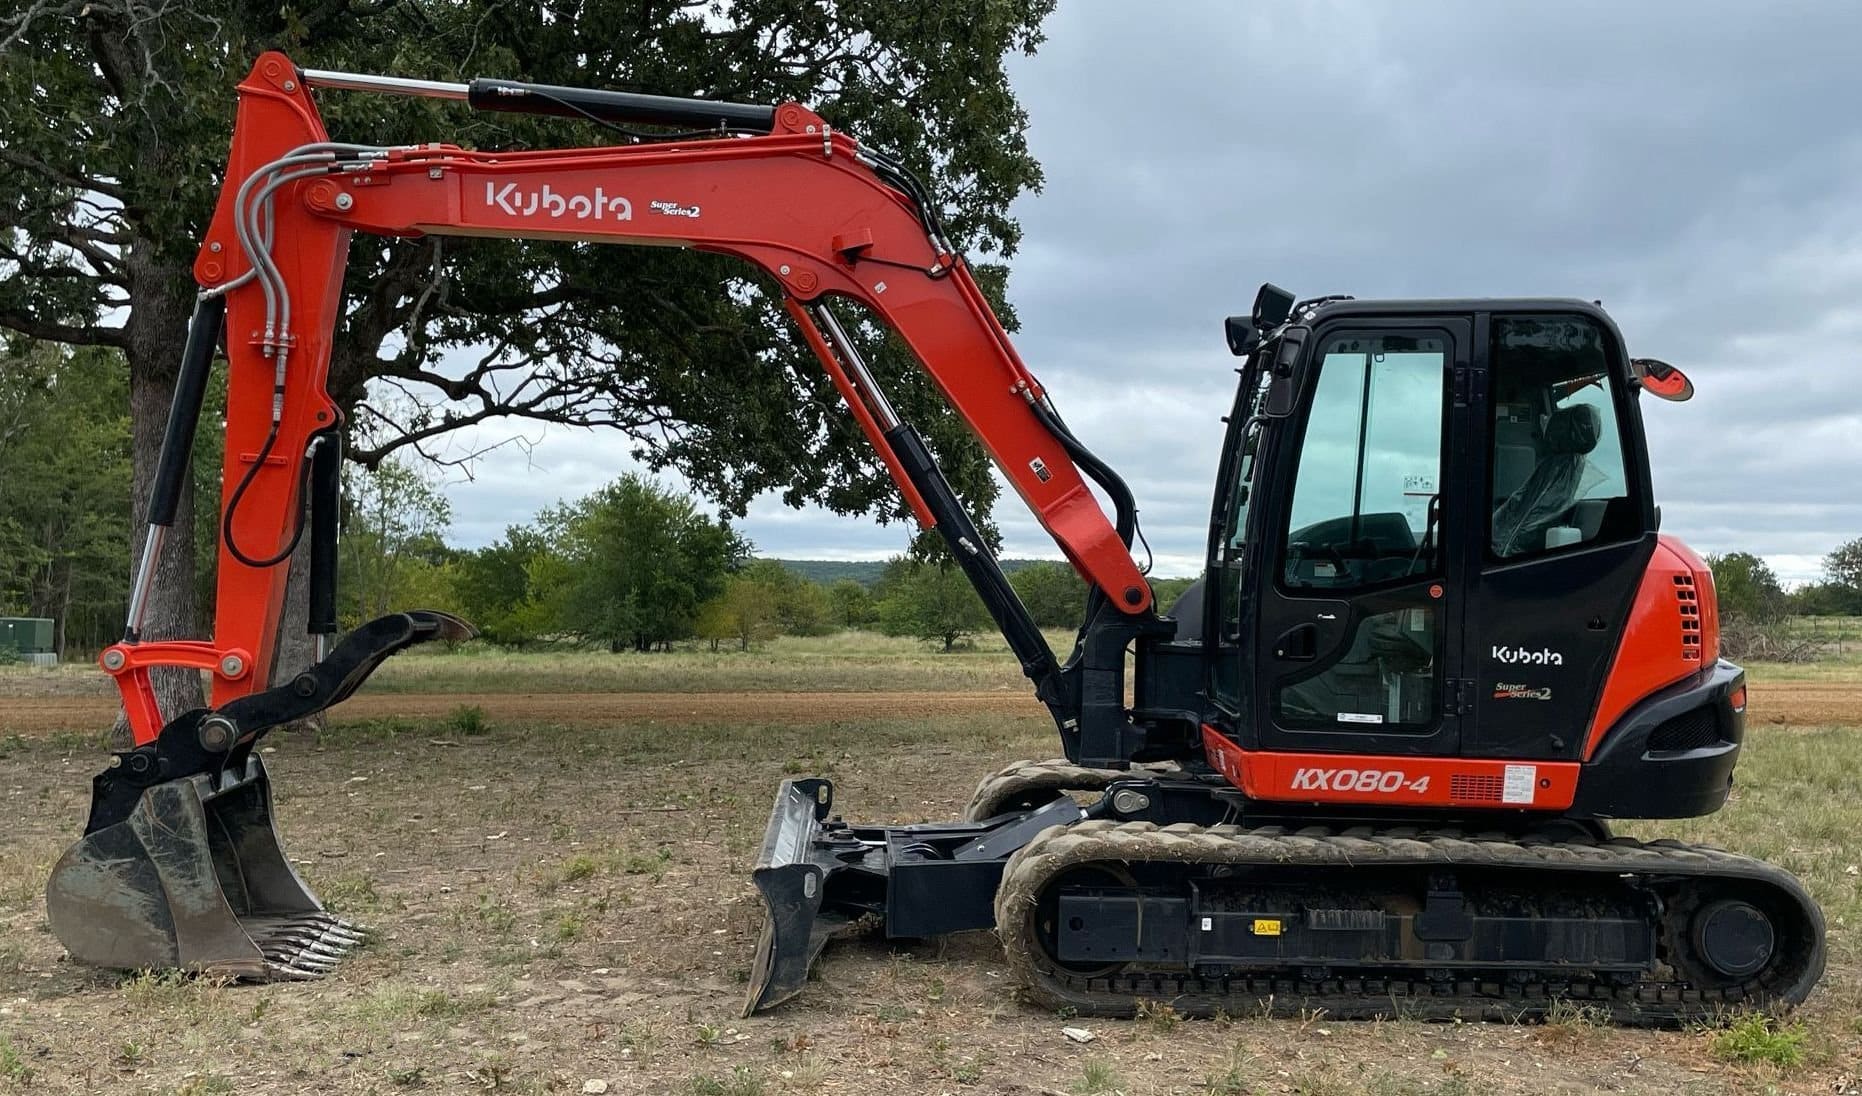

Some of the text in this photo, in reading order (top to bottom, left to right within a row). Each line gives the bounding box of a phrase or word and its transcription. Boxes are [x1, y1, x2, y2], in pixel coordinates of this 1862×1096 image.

[486, 182, 632, 221] Kubota
[650, 200, 678, 210] Super
[1492, 646, 1562, 665] Kubota
[1495, 682, 1527, 692] Super
[1291, 768, 1430, 793] KX080-4
